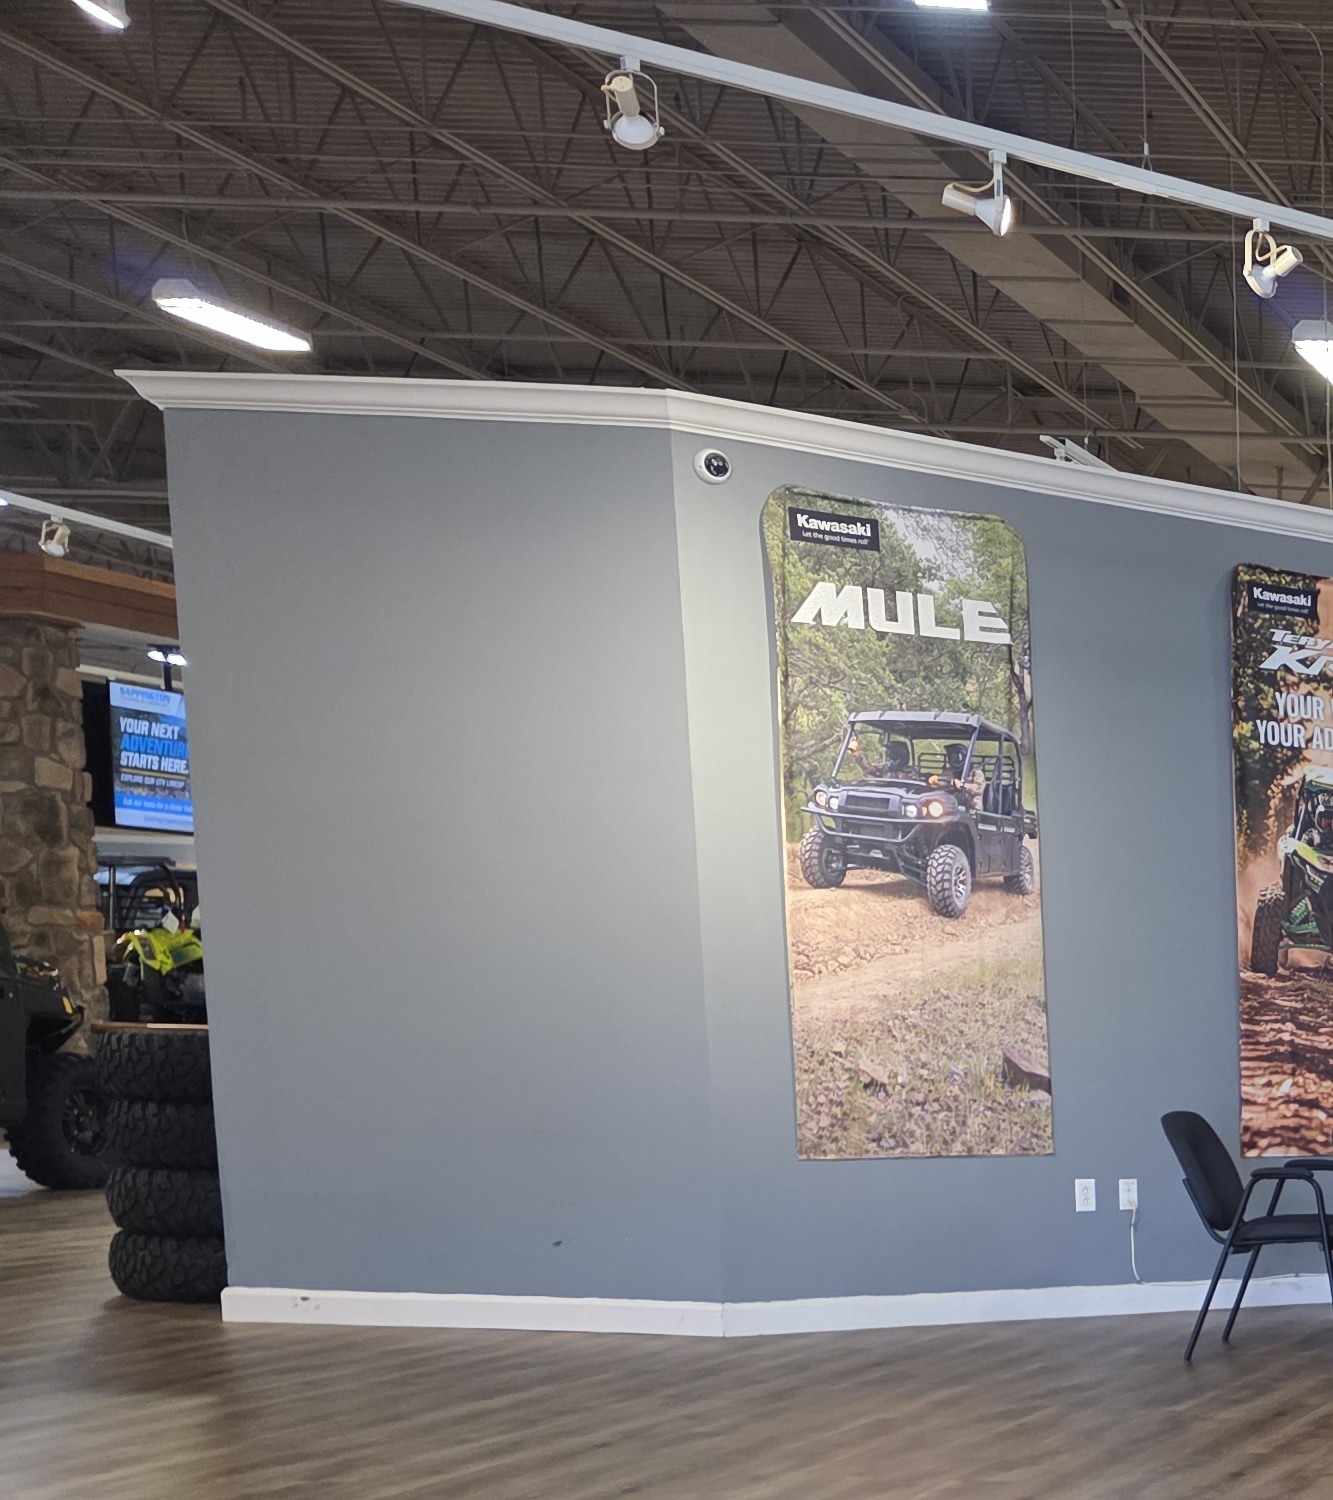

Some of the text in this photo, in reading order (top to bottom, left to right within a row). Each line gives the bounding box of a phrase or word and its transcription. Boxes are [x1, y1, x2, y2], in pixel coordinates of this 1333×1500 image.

[796, 514, 871, 537] Kawasaki
[813, 532, 823, 540] the
[1253, 587, 1312, 607] Kawasaki
[790, 581, 1013, 646] MULE
[1275, 691, 1325, 721] YOUR
[119, 716, 180, 741] YOUR NEXT
[1256, 719, 1306, 749] YOUR
[120, 751, 189, 775] STARTS HERE.
